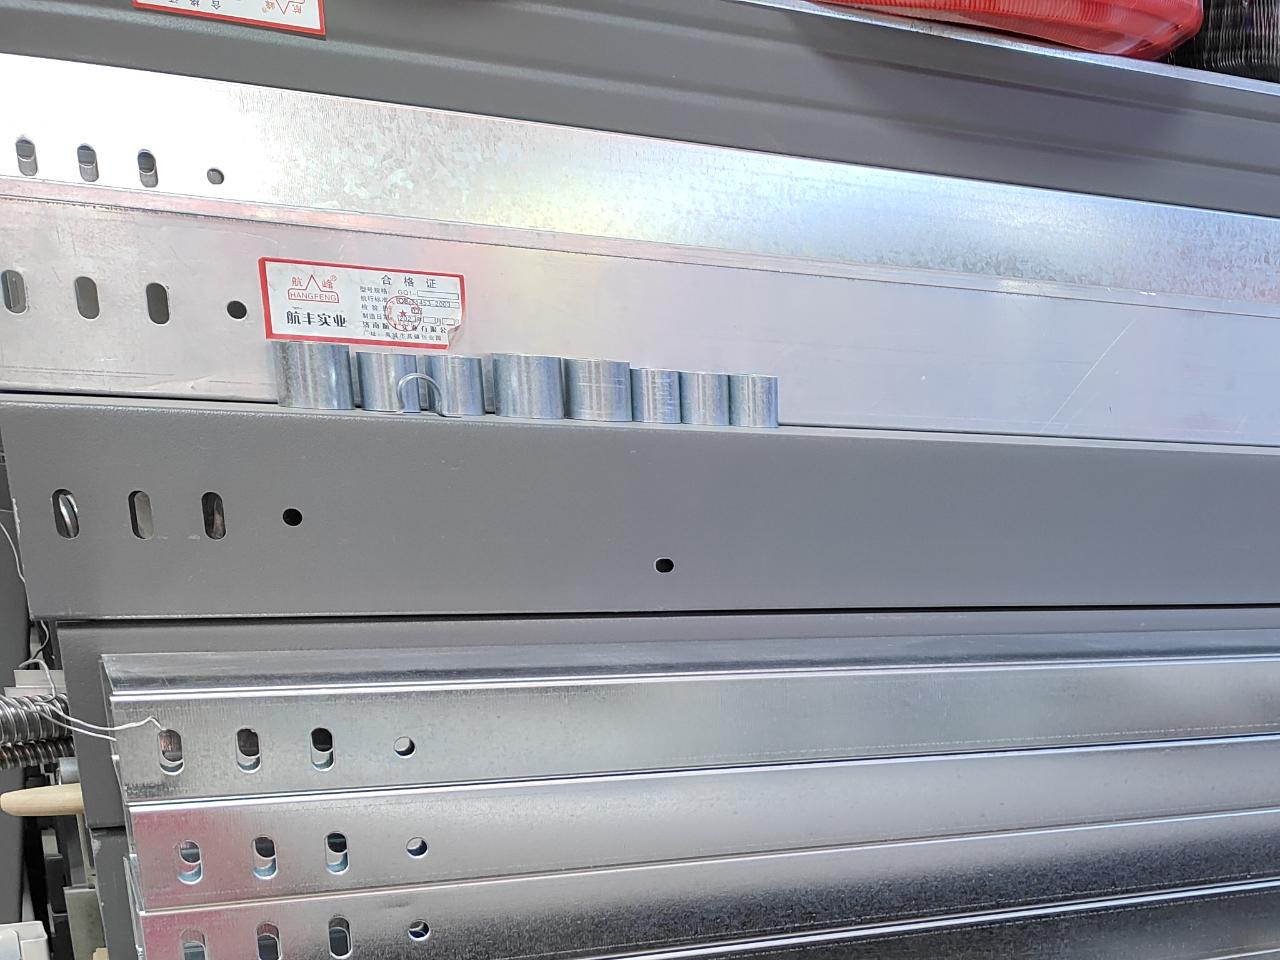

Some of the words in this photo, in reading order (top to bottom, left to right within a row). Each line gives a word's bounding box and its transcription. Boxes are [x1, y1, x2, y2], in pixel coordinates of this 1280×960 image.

[381, 275, 437, 288] 合格证
[289, 291, 337, 302] HANGFENG
[286, 310, 347, 328] 航丰实业
